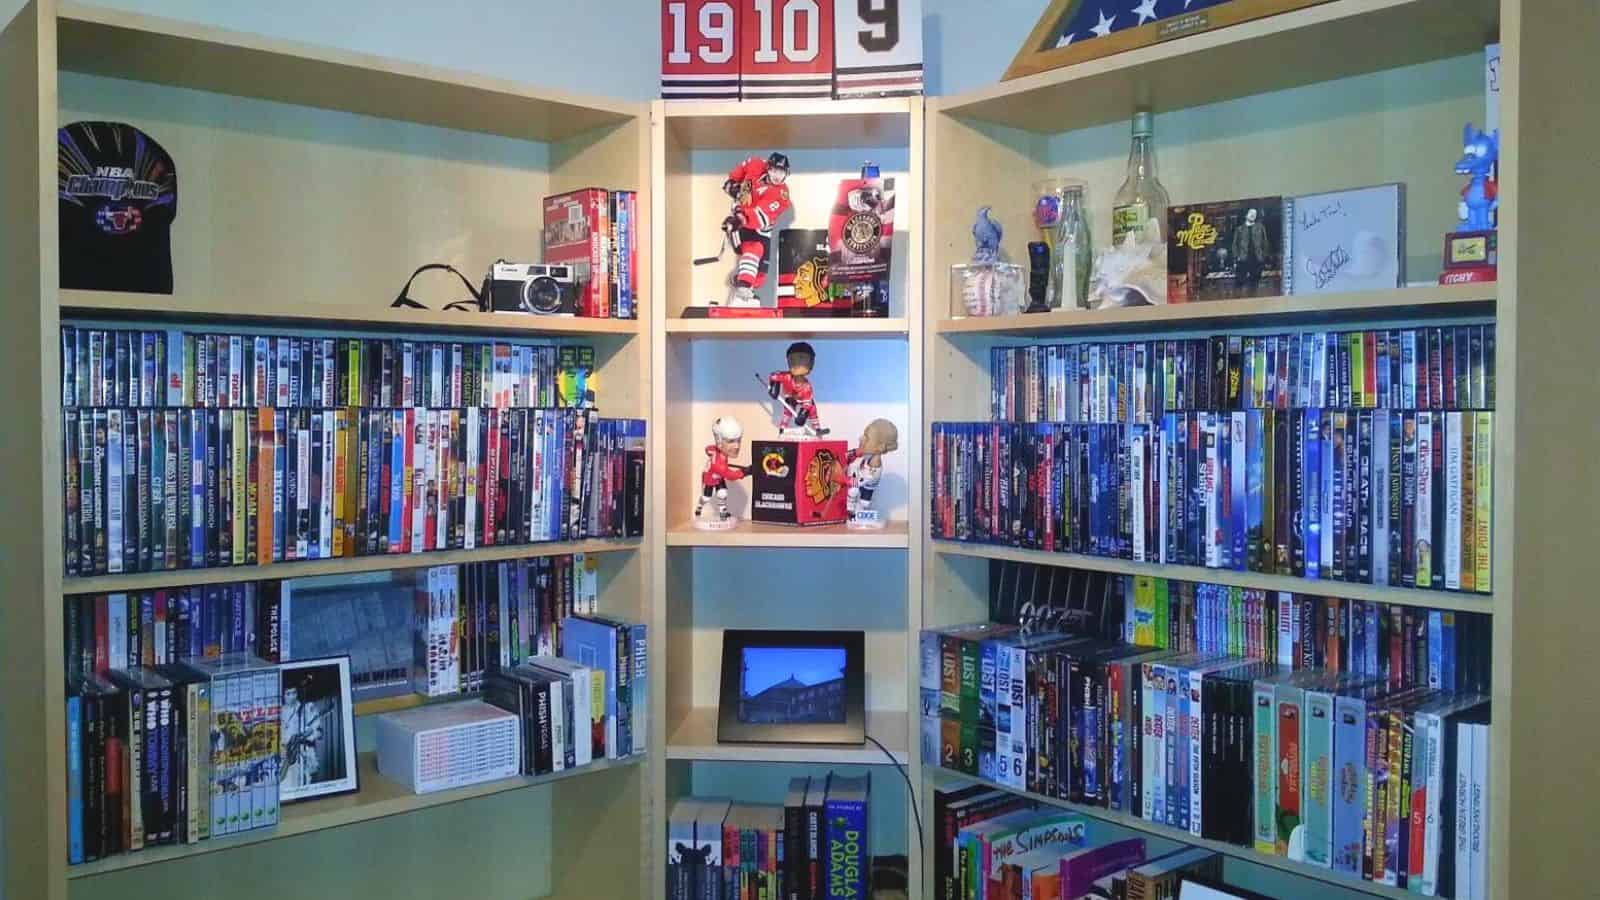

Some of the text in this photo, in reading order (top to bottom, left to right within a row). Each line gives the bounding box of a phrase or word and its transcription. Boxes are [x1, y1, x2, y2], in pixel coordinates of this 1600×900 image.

[668, 2, 734, 63] 19
[754, 0, 820, 62] 10
[857, 0, 900, 53] 9
[96, 166, 134, 178] NBA
[1444, 271, 1474, 284] ITCHY
[1448, 447, 1458, 463] JIM
[167, 453, 176, 529] ACROSS THE UNIVERSE
[208, 446, 216, 529] BEING JOHN MALKOVICH
[249, 482, 257, 516] MOAN
[488, 448, 496, 528] SPIDER-MAN
[754, 501, 793, 510] BLACKHAWKS
[1177, 456, 1185, 530] MINORITY REPORT
[1360, 456, 1369, 556] DEATH RACE
[1390, 472, 1401, 520] LABYRINTH
[81, 489, 91, 524] CONTROL
[1478, 520, 1489, 572] THE POINT
[270, 604, 279, 653] THE POLICE
[1303, 601, 1313, 651] CINCINNATI
[619, 656, 628, 687] PHISH
[635, 640, 645, 677] PHISH
[943, 652, 956, 683] LOST
[963, 656, 975, 688] LOST
[981, 658, 995, 692] LOST
[999, 667, 1010, 694] LOST
[1011, 679, 1024, 710] LOST
[146, 699, 157, 730] WHO
[159, 698, 171, 726] WHO
[536, 692, 548, 750] PHISH VEGAS
[146, 730, 157, 775] TOMMY
[945, 744, 954, 763] 2
[964, 748, 973, 767] 3
[1013, 758, 1023, 777] 6
[1402, 734, 1412, 773] FUTURAMA
[831, 840, 844, 896] ADAMS
[844, 831, 858, 900] DOUGLA
